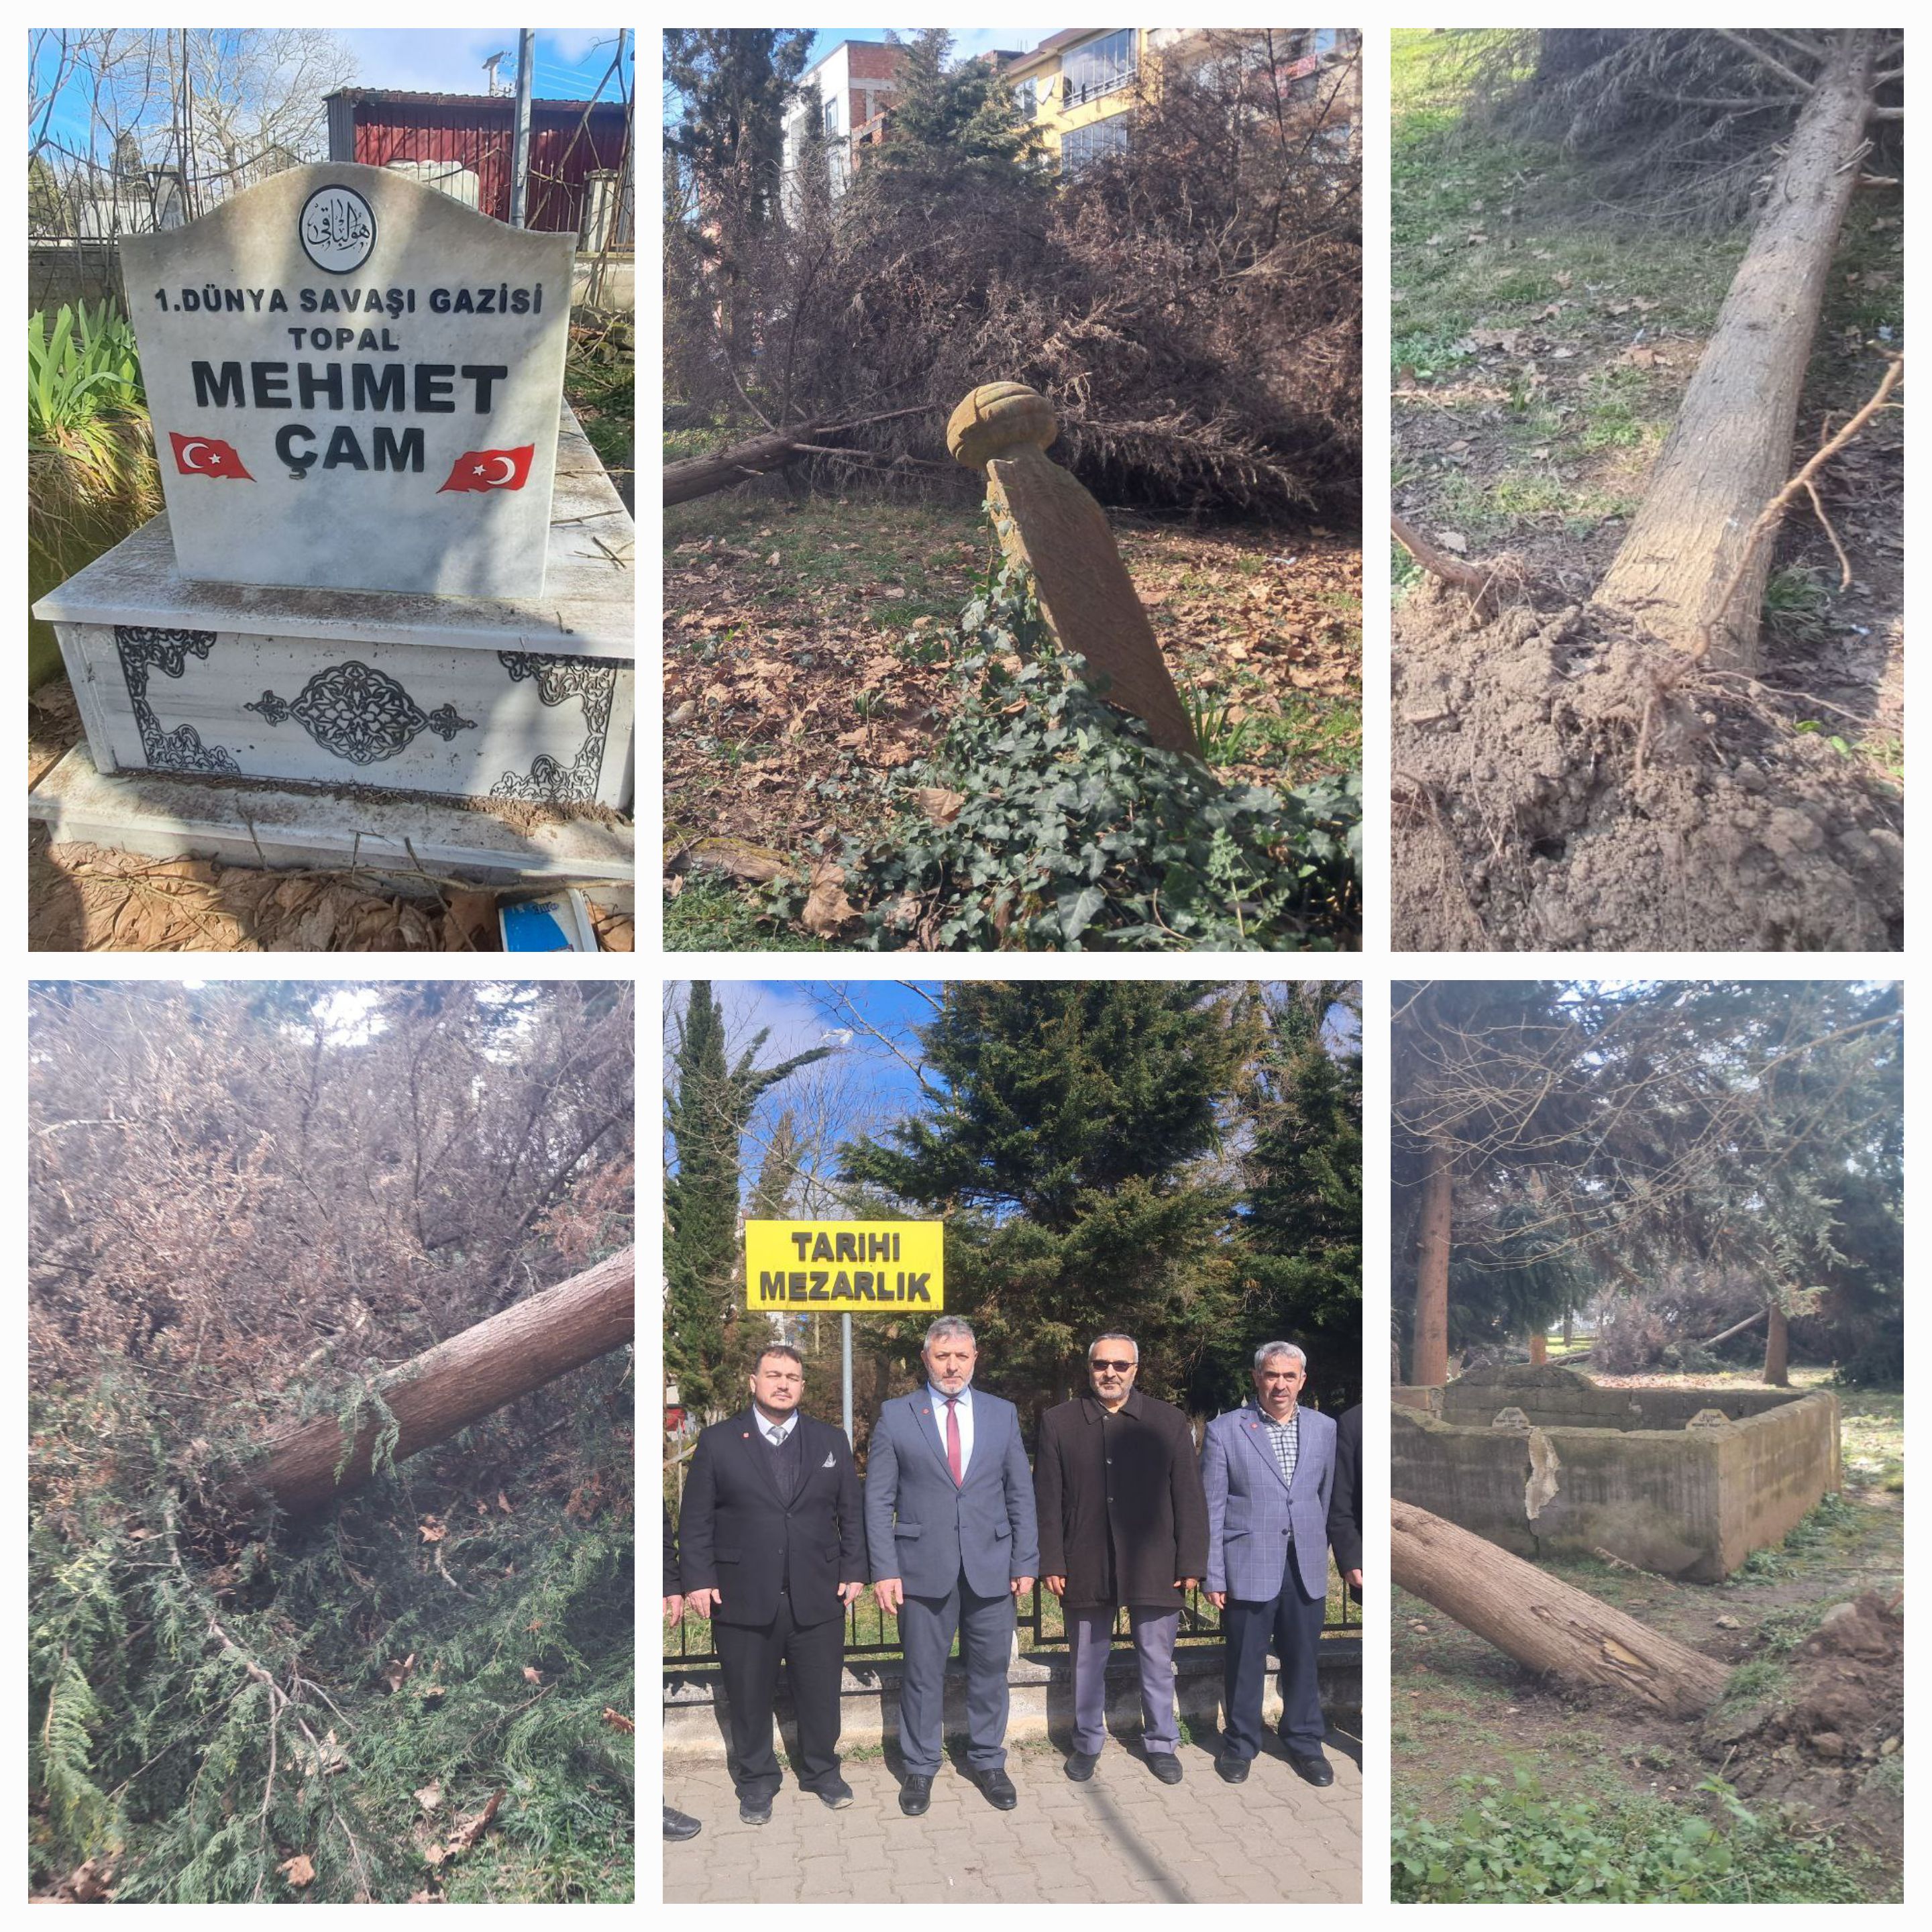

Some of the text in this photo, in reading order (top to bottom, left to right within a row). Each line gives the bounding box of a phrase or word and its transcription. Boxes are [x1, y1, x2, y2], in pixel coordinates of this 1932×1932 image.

[154, 282, 543, 320] 1.DÜNYA SAVAŞI GAZİSİ
[288, 327, 400, 352] TOPAL
[191, 360, 508, 415] MEHMET
[274, 423, 425, 480] ÇAM
[759, 1271, 931, 1302] MEZARLIK
